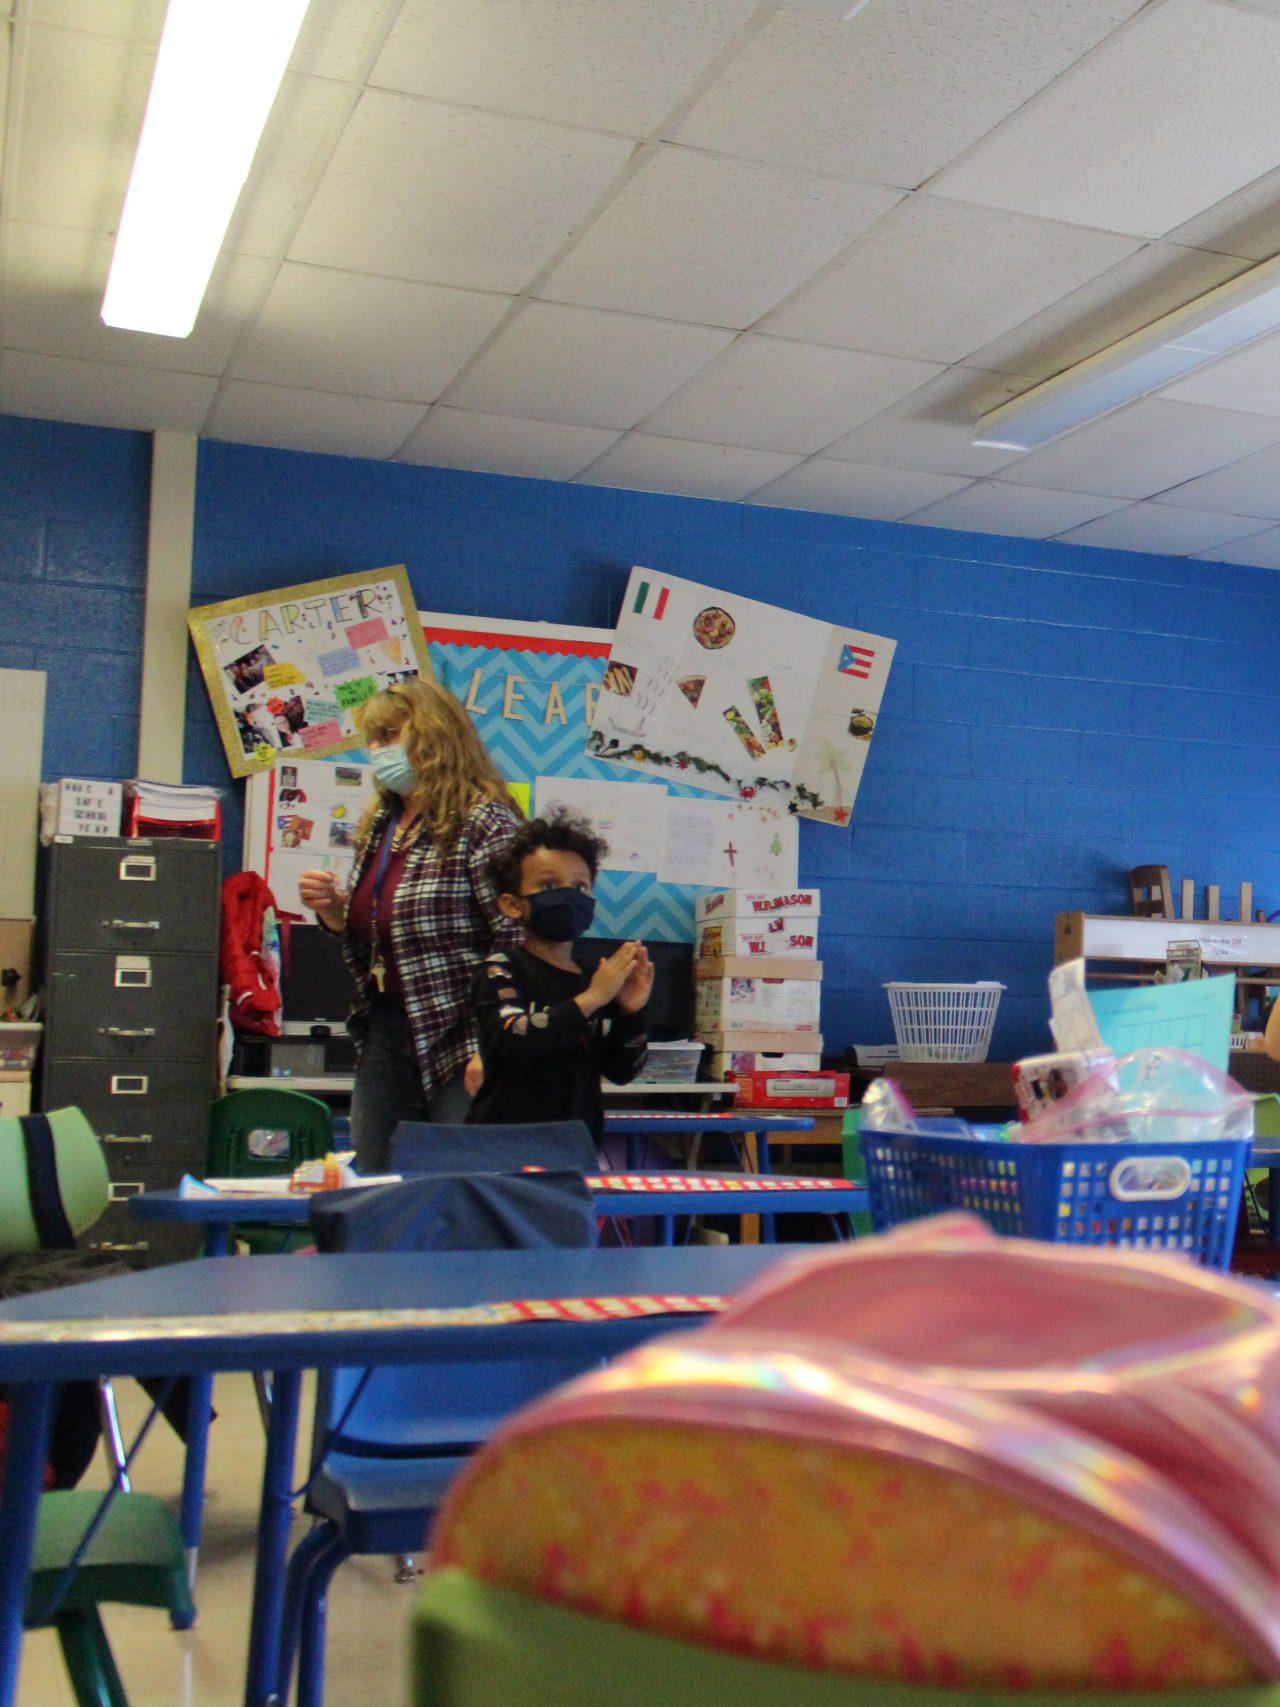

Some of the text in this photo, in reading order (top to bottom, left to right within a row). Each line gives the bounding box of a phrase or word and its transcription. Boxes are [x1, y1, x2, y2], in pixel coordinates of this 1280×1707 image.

[229, 588, 383, 645] CARTER
[64, 783, 92, 794] HAVE
[76, 797, 103, 808] SAFE
[74, 810, 108, 821] SCHOOL
[79, 823, 109, 833] YEAR
